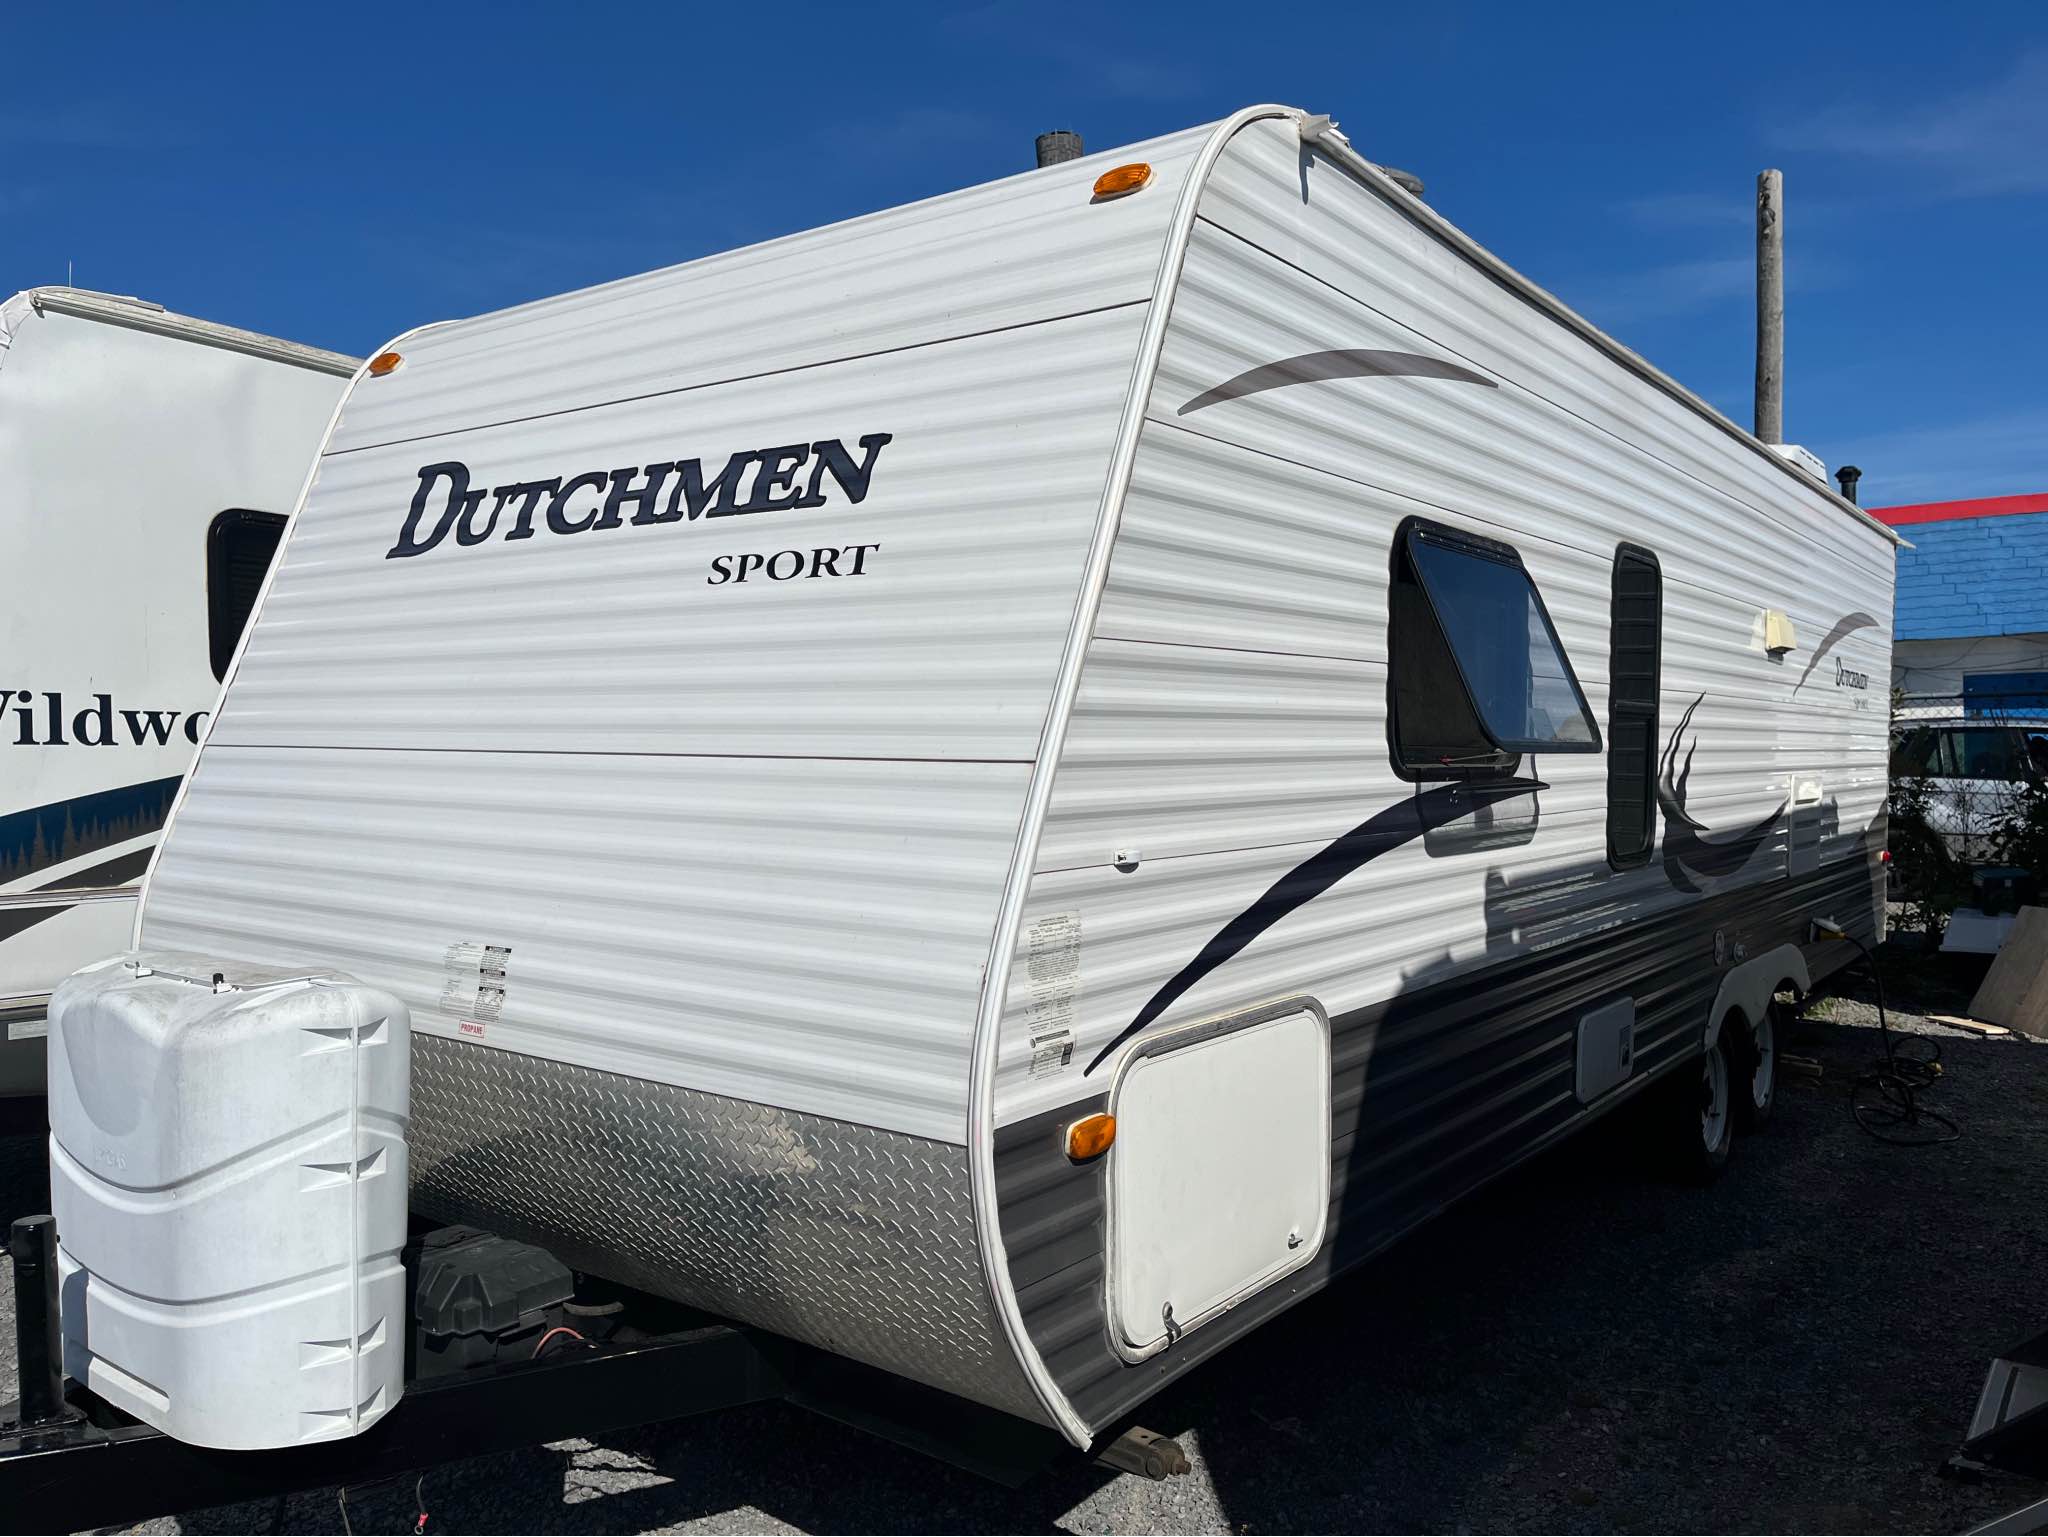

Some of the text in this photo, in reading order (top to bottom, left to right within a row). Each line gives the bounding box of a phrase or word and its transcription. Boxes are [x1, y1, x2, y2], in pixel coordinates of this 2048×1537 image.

[385, 432, 892, 559] DUTCHMEN
[707, 543, 880, 584] SPORT
[460, 1023, 483, 1035] PROPANE
